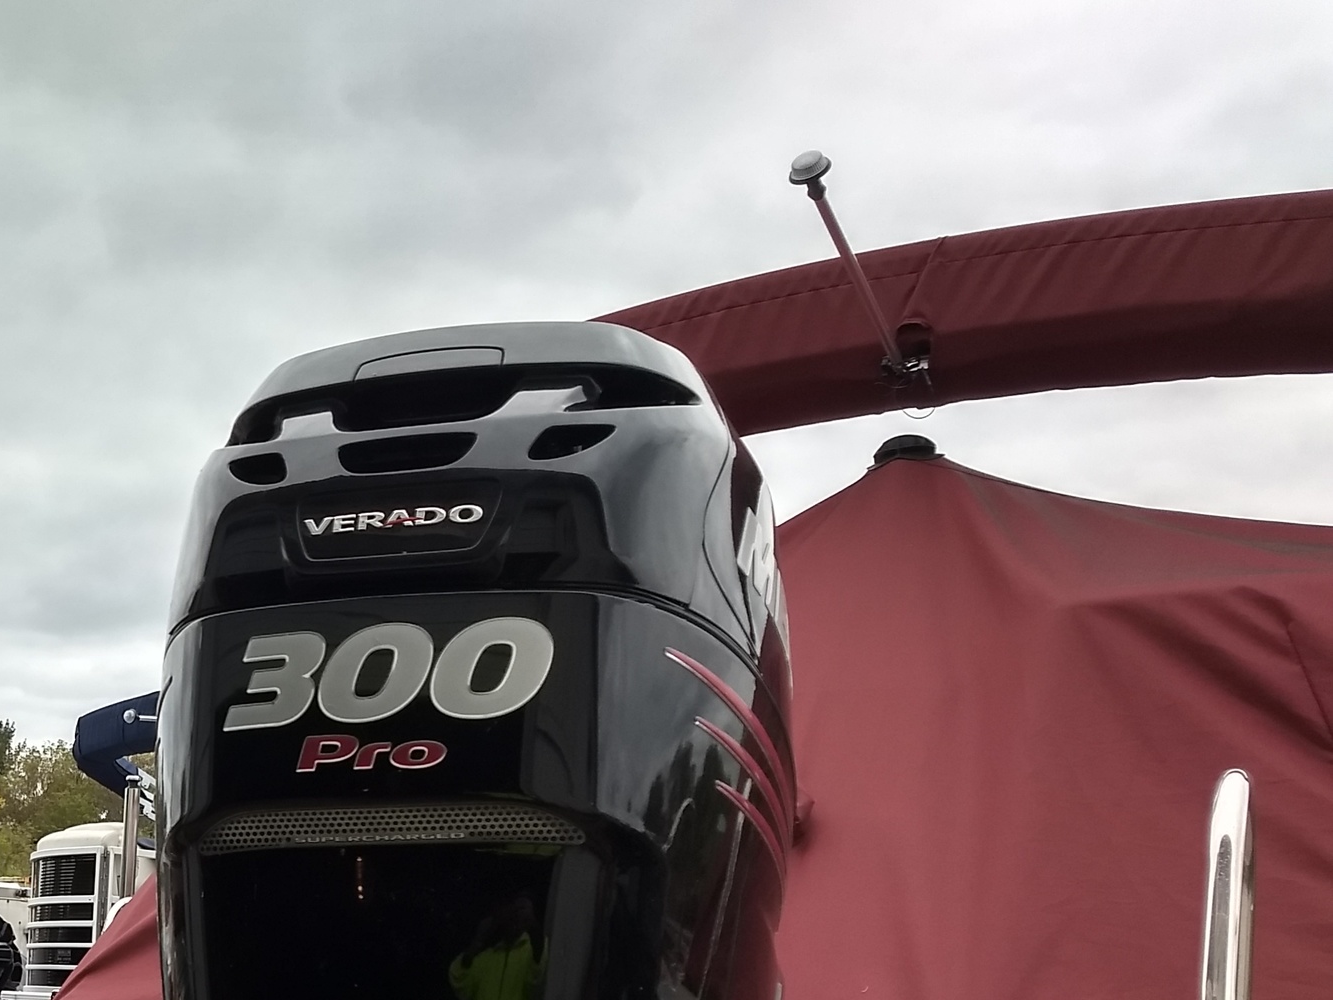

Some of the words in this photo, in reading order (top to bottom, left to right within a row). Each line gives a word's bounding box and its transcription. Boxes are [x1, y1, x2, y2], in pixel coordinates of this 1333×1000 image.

[303, 504, 484, 536] VERADO
[223, 616, 554, 732] 300
[295, 734, 448, 773] Pro
[294, 832, 465, 844] SUPERCHARGED
